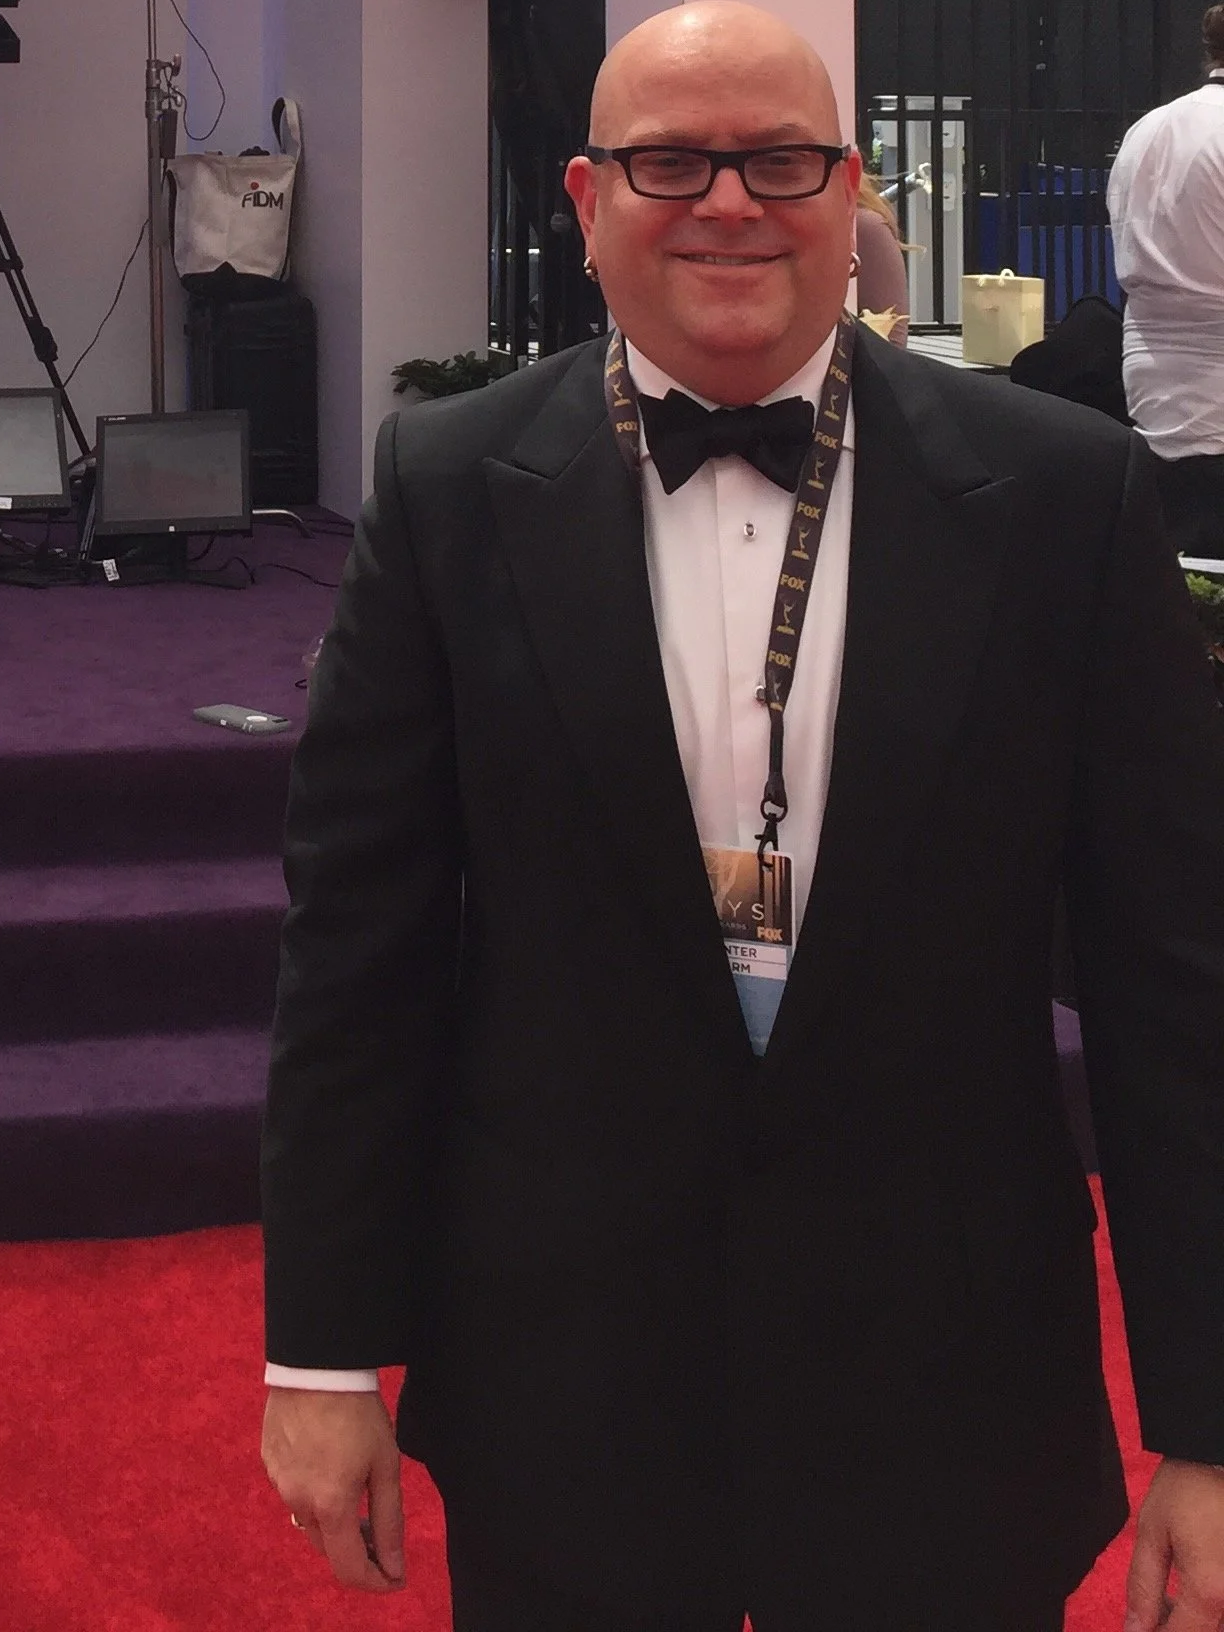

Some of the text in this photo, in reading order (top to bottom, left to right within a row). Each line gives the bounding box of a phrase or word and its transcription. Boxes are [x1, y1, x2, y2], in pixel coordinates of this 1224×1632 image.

[242, 191, 284, 210] FIDM
[830, 364, 848, 384] FOX
[815, 431, 838, 449] FOX
[796, 502, 822, 520] FOX
[780, 574, 807, 592] FOX
[768, 650, 792, 668] FOX
[756, 926, 783, 941] FOX
